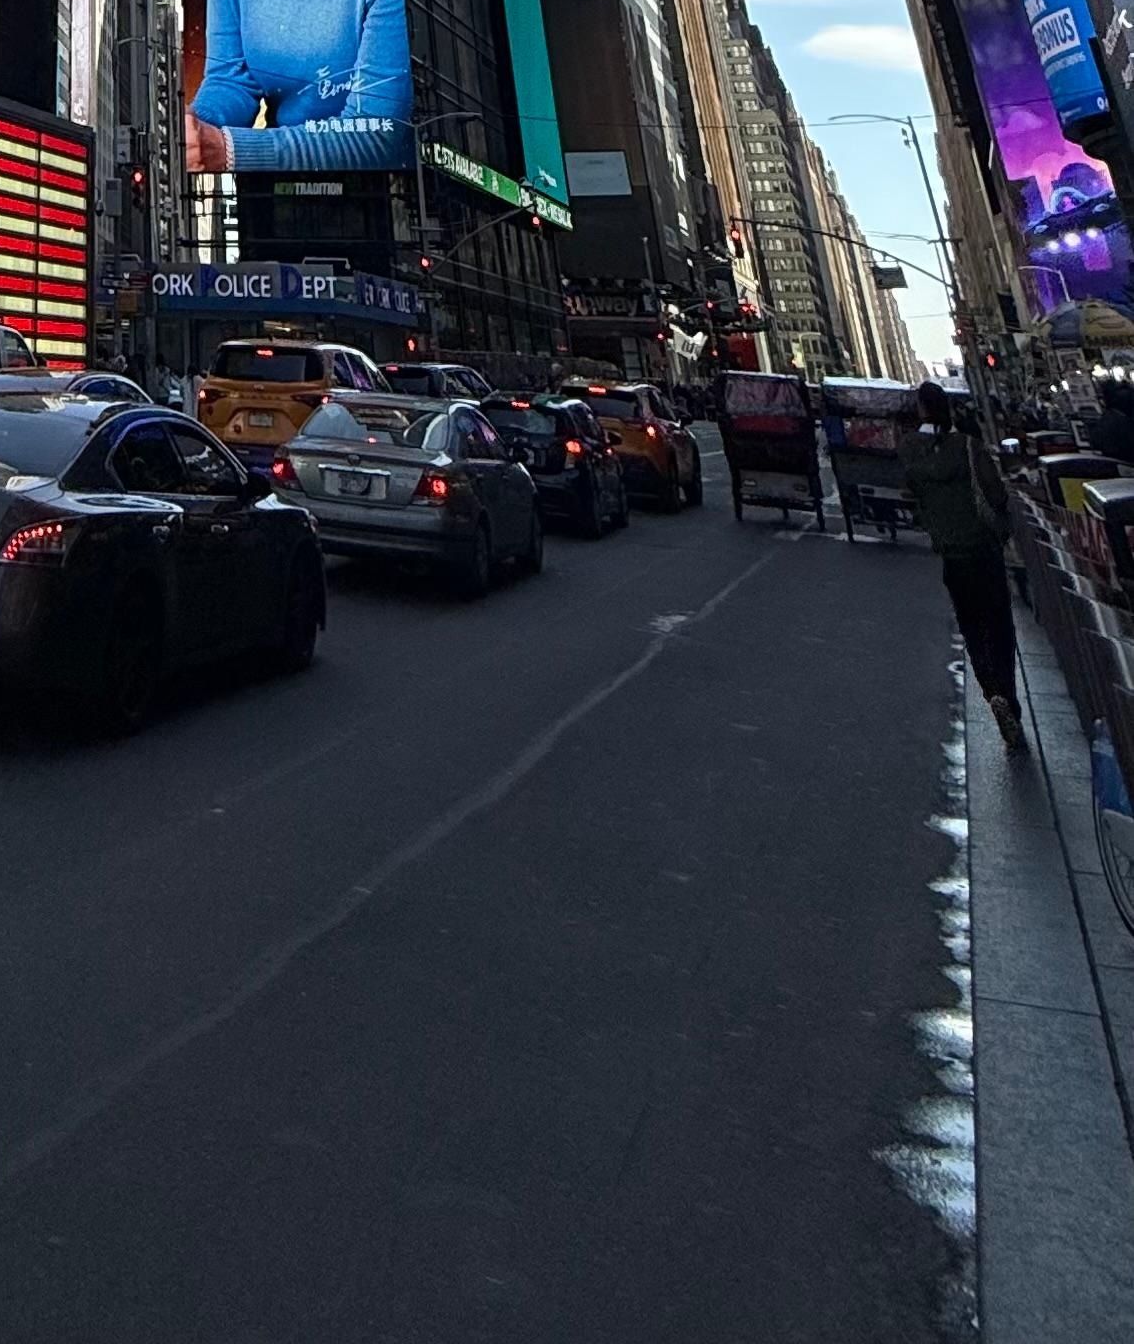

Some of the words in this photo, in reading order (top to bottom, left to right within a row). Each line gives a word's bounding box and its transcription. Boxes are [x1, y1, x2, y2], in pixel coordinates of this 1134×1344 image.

[152, 273, 194, 296] ORK
[199, 264, 272, 298] POLICE
[280, 265, 337, 299] DEPT
